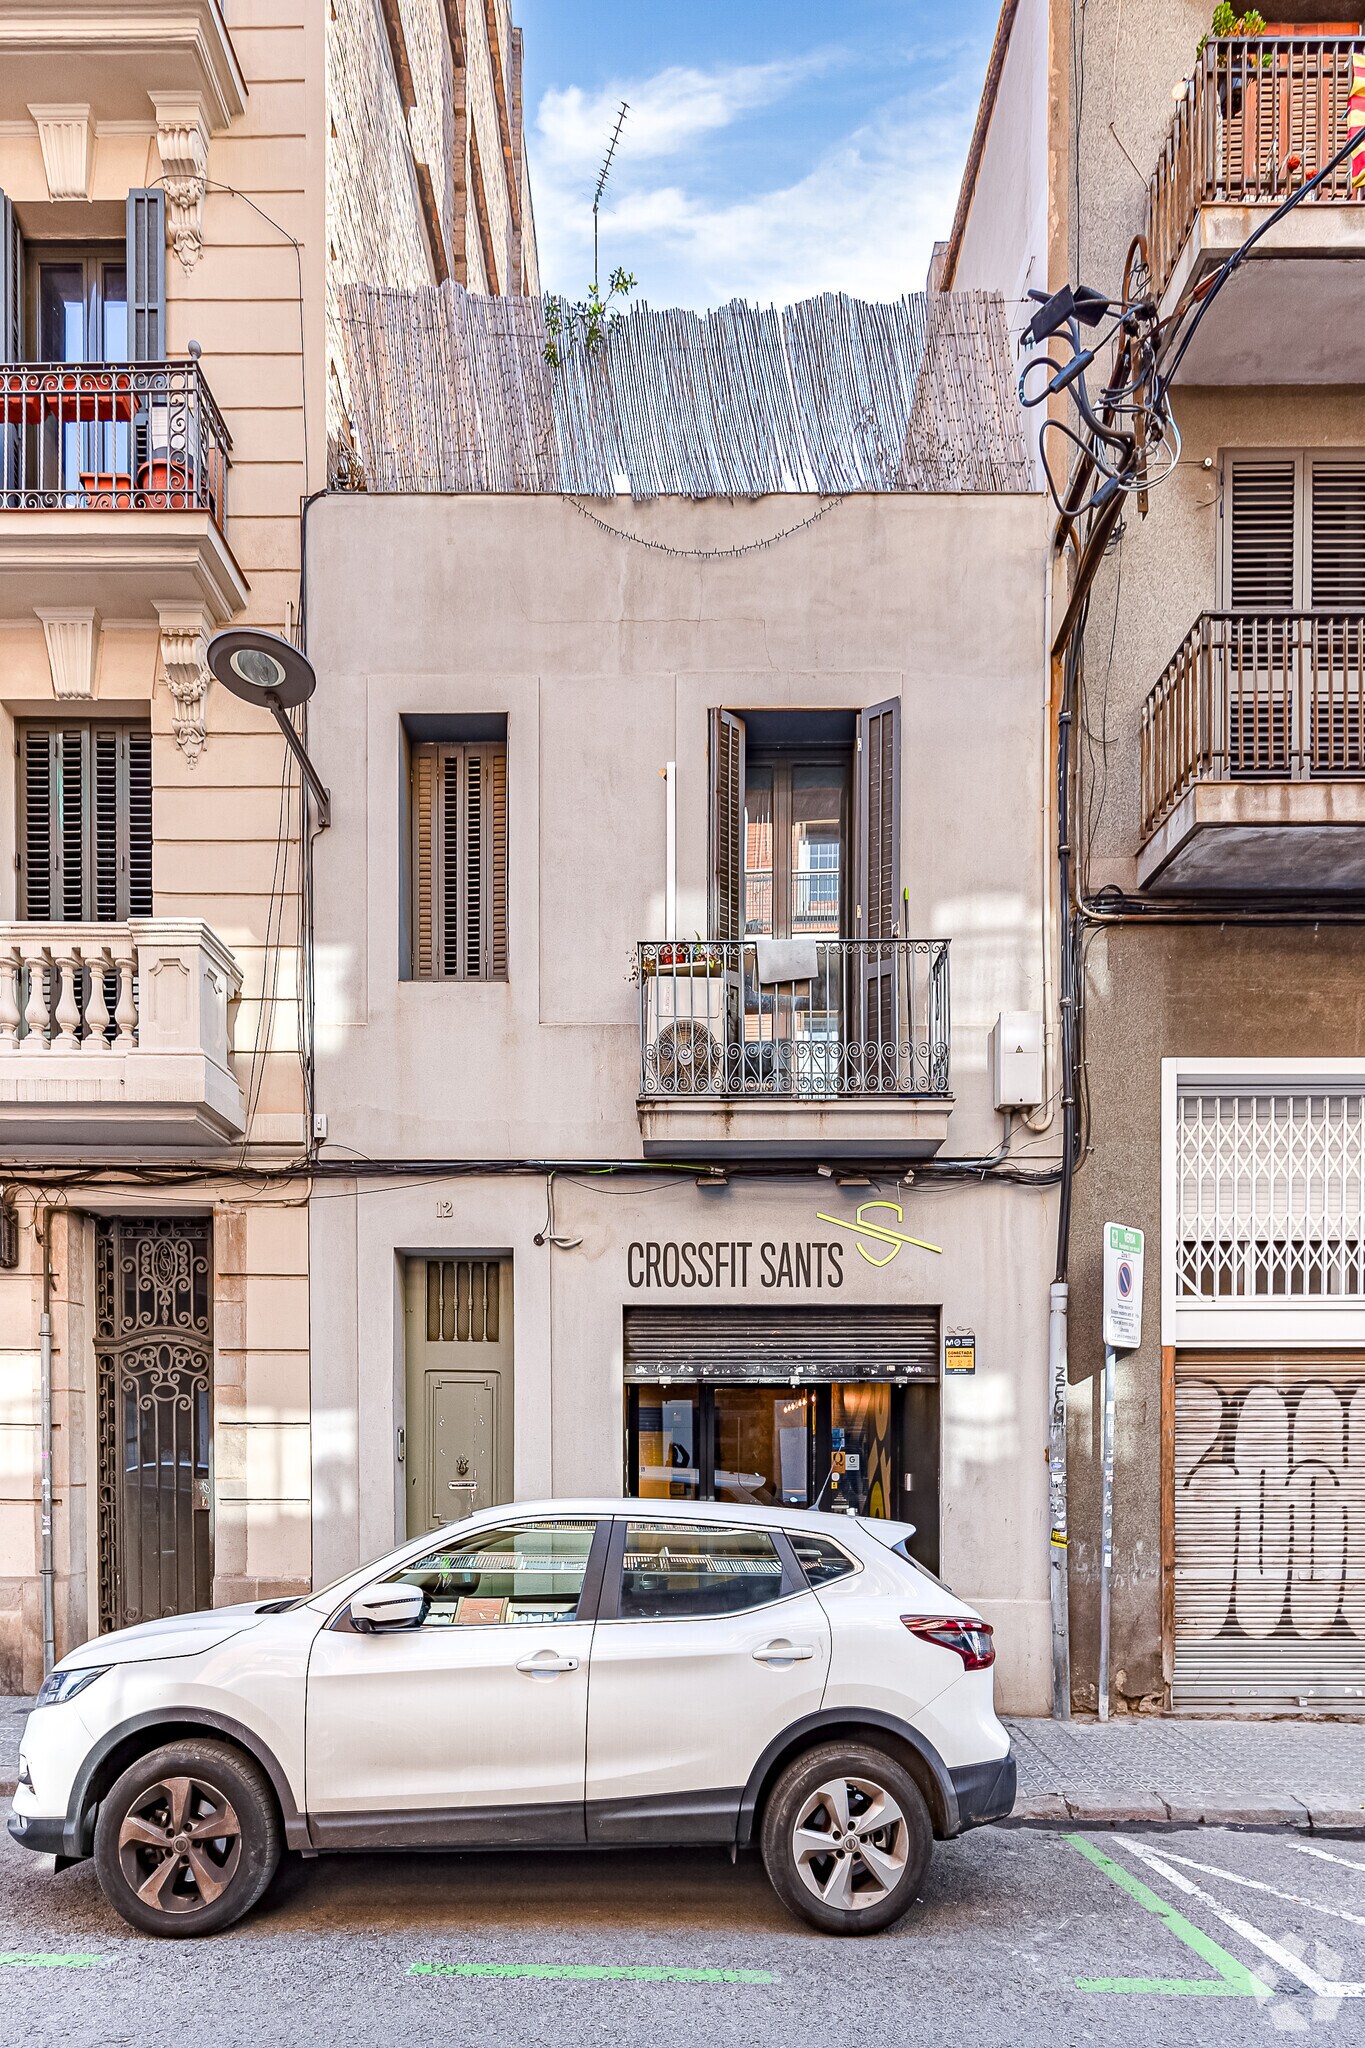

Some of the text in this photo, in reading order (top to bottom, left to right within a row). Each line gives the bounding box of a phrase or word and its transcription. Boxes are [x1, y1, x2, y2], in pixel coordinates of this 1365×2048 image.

[436, 1200, 454, 1219] 12
[627, 1241, 844, 1288] CROSSFIT SANTS
